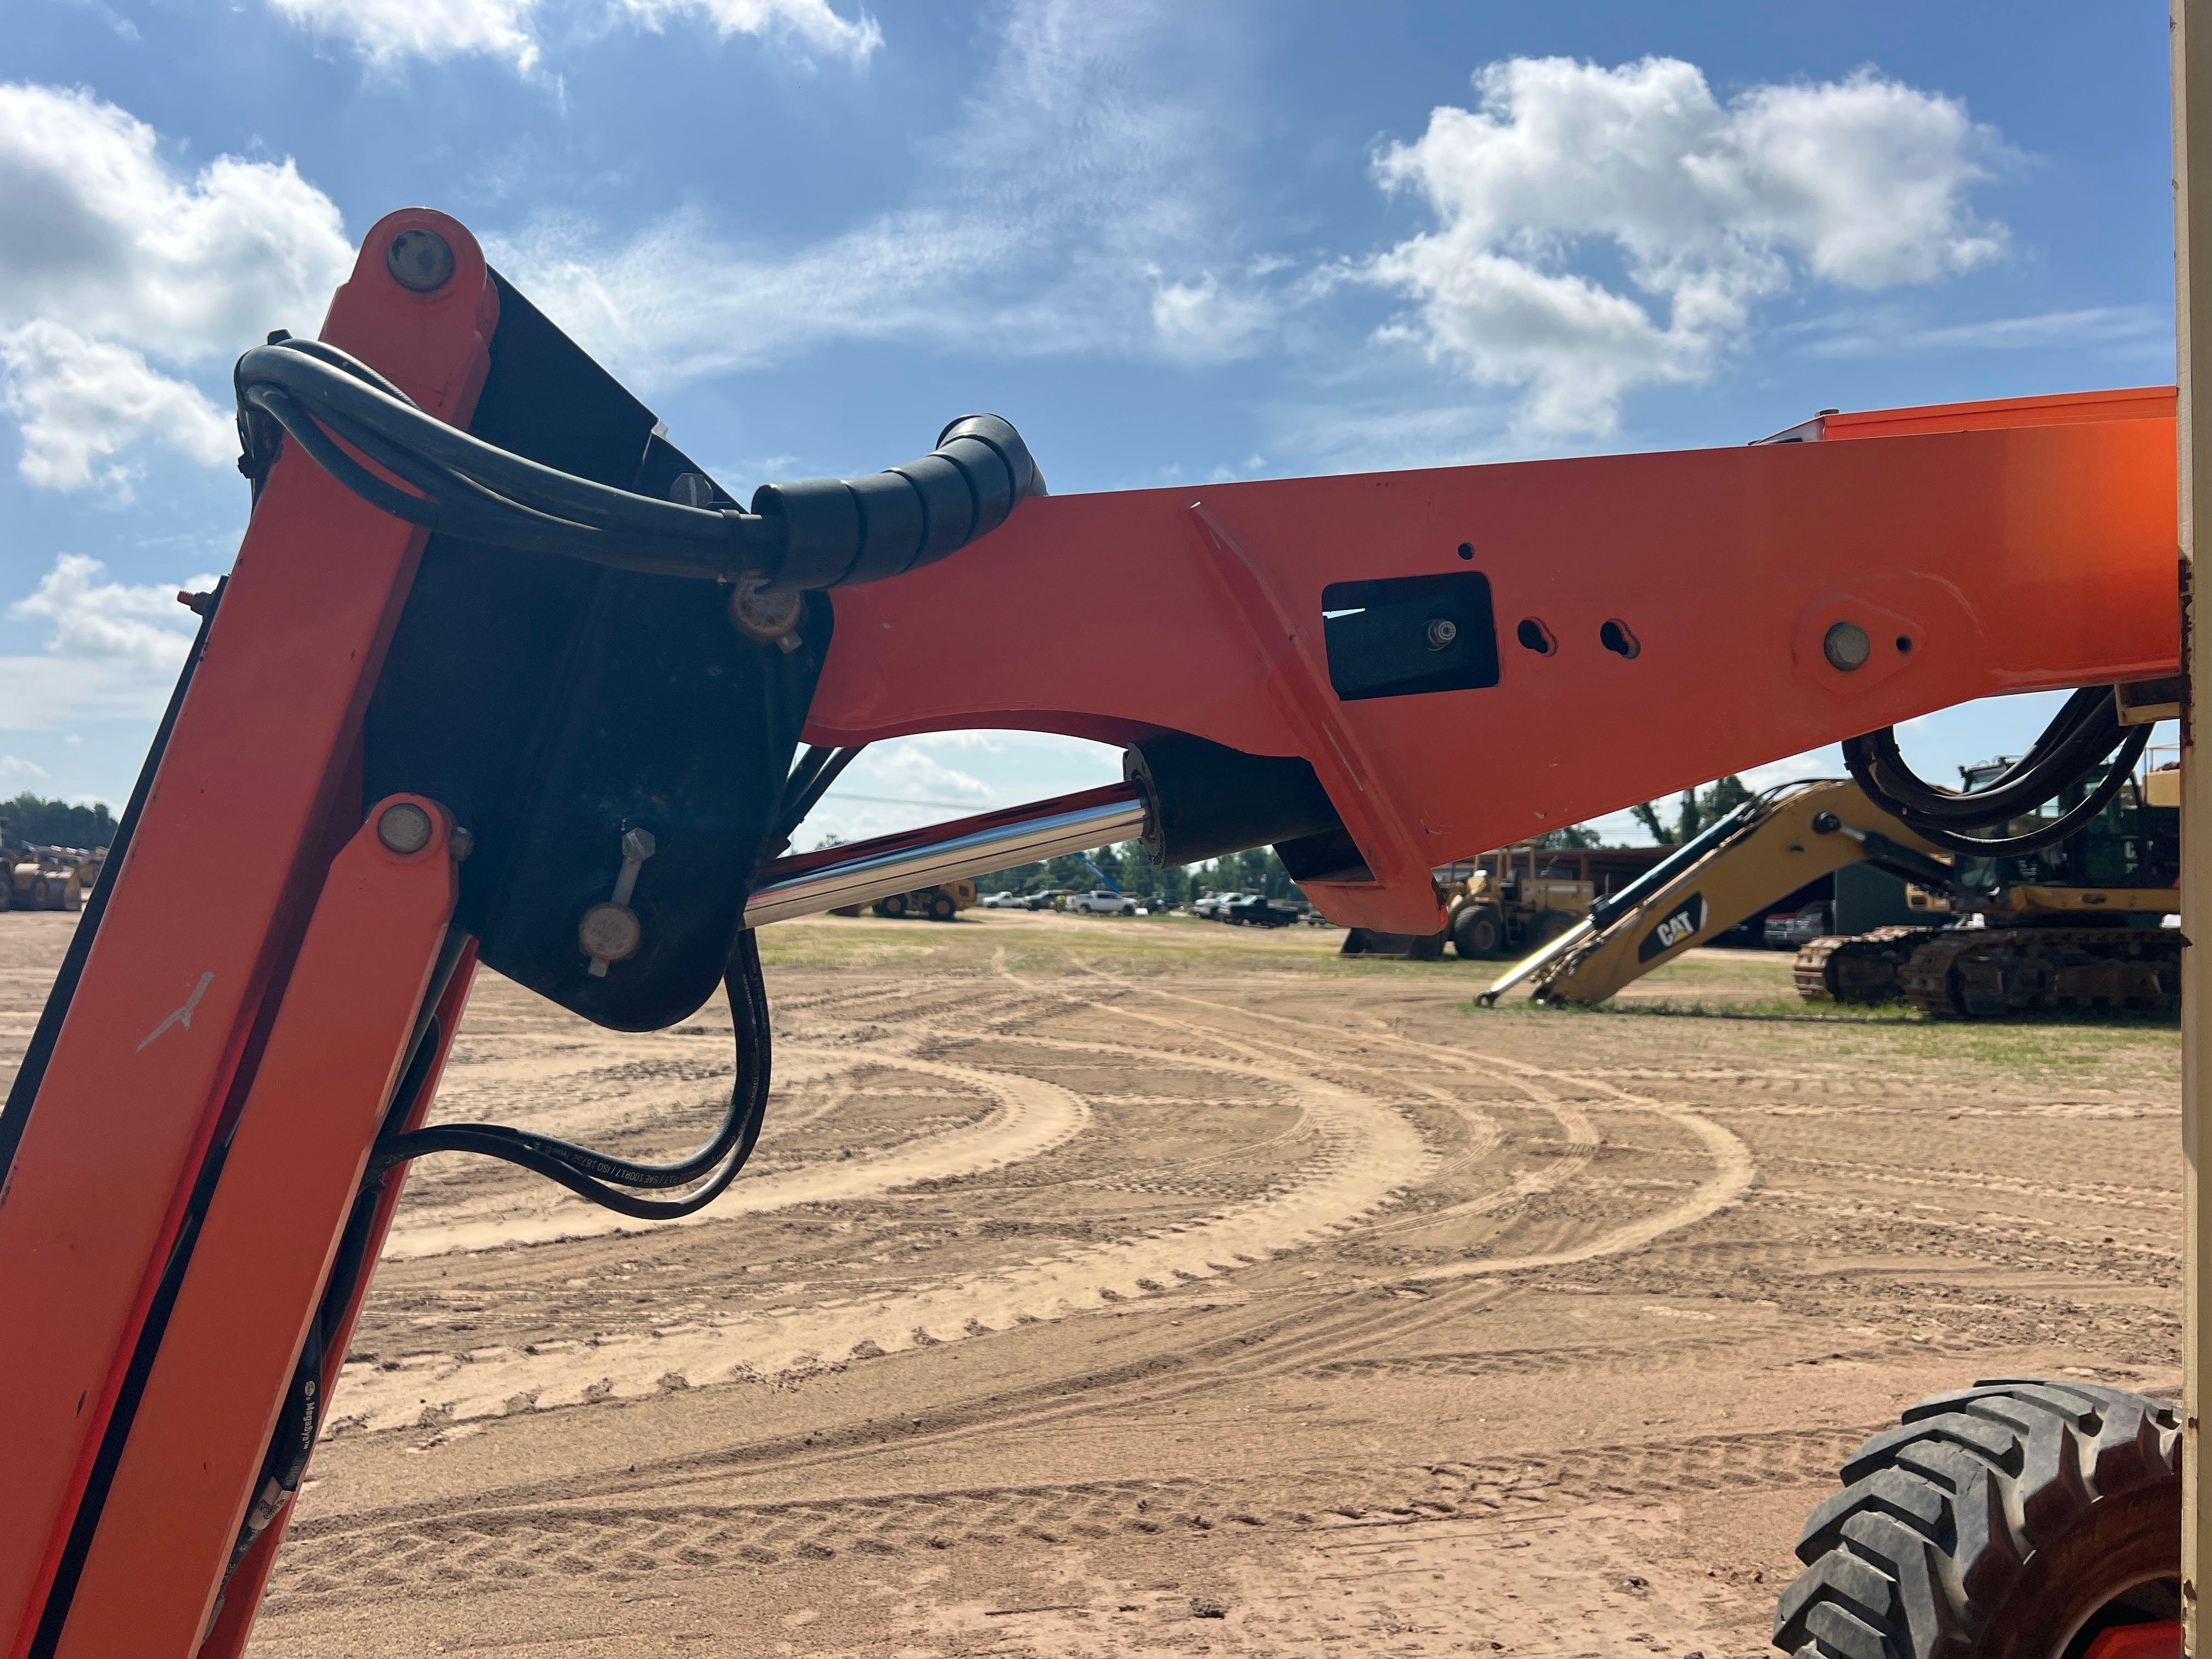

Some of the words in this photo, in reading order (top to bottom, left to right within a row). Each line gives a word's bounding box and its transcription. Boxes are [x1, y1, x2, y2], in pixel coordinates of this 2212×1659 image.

[1657, 911, 1694, 946] CAT
[597, 1162, 611, 1173] ISO
[616, 1168, 645, 1182] 100R17
[644, 1175, 659, 1184] SAE
